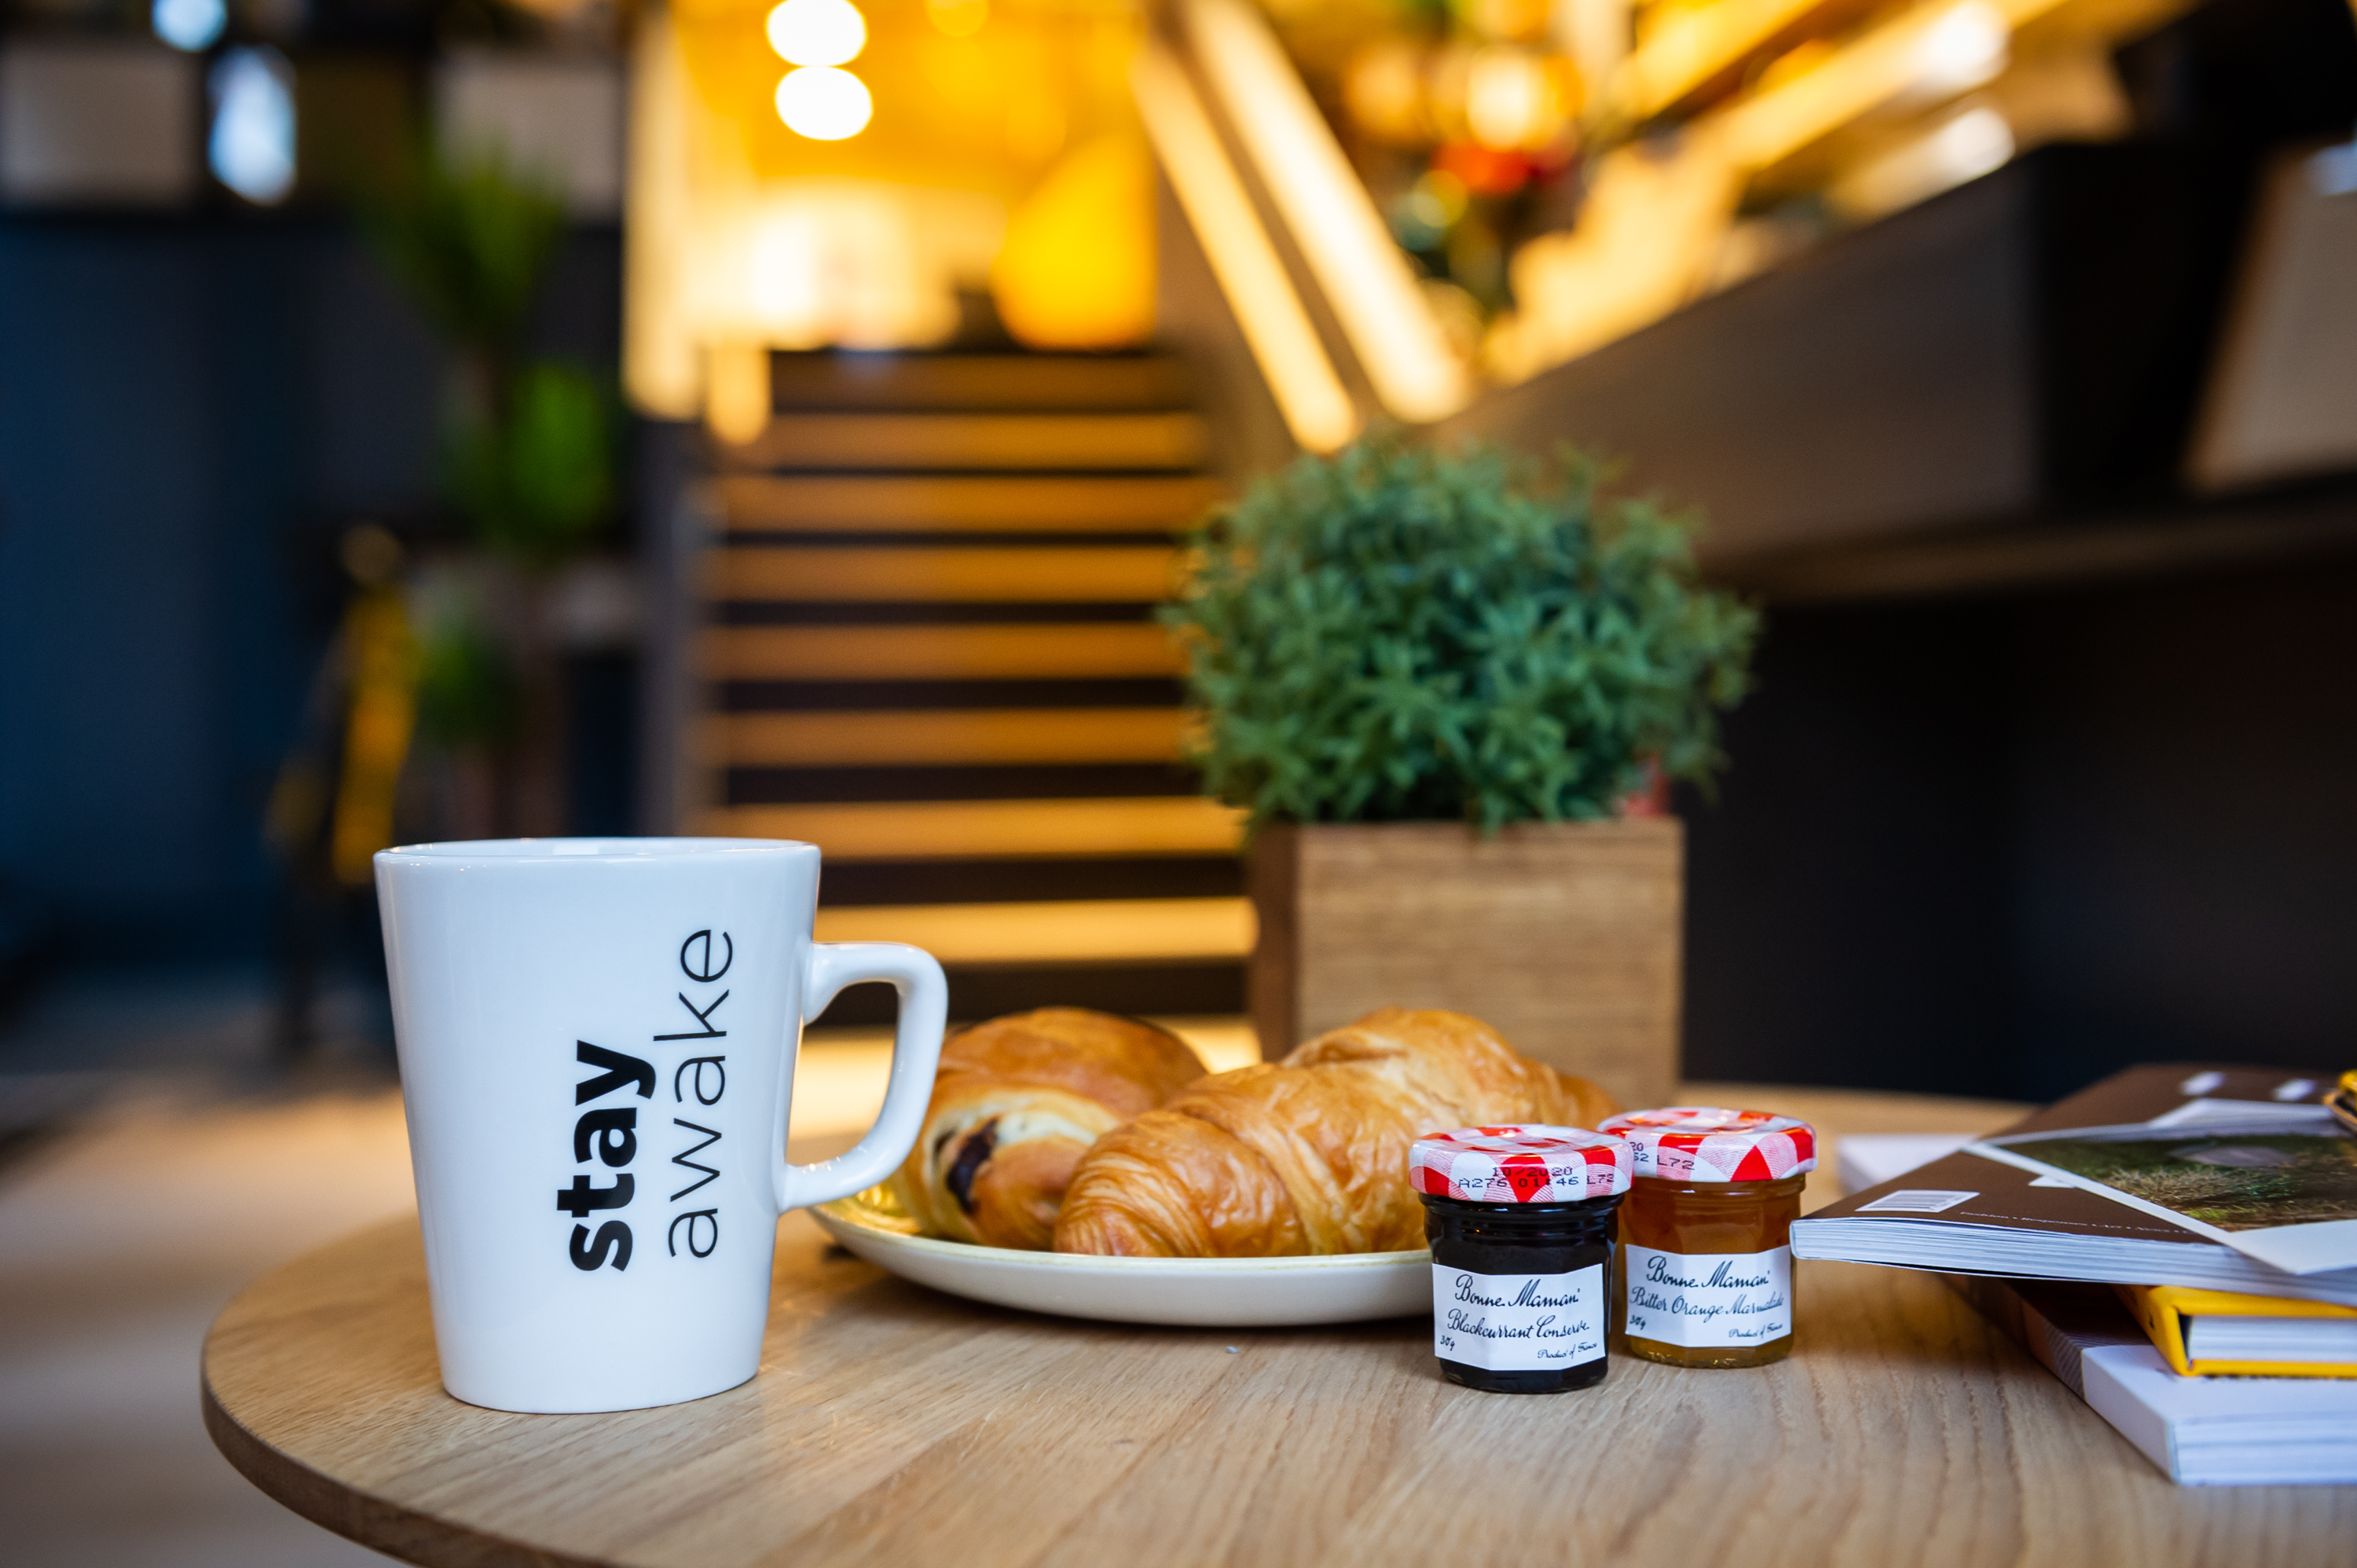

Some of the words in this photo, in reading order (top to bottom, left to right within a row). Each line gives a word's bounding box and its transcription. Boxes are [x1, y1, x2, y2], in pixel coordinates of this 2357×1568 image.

[653, 929, 733, 1259] awake
[556, 1039, 657, 1272] stay
[1493, 1167, 1572, 1178] 10/2020
[1646, 1255, 1699, 1288] Bonne
[1701, 1260, 1769, 1288] Maman
[1454, 1273, 1505, 1306] Bonne
[1507, 1278, 1579, 1307] Maman
[1629, 1286, 1667, 1312] Bitter
[1671, 1295, 1724, 1323] Orange
[1447, 1308, 1534, 1339] Blackcurrant
[1536, 1314, 1589, 1338] Conserve
[1440, 1335, 1455, 1351] 30g
[1569, 1343, 1576, 1359] of
